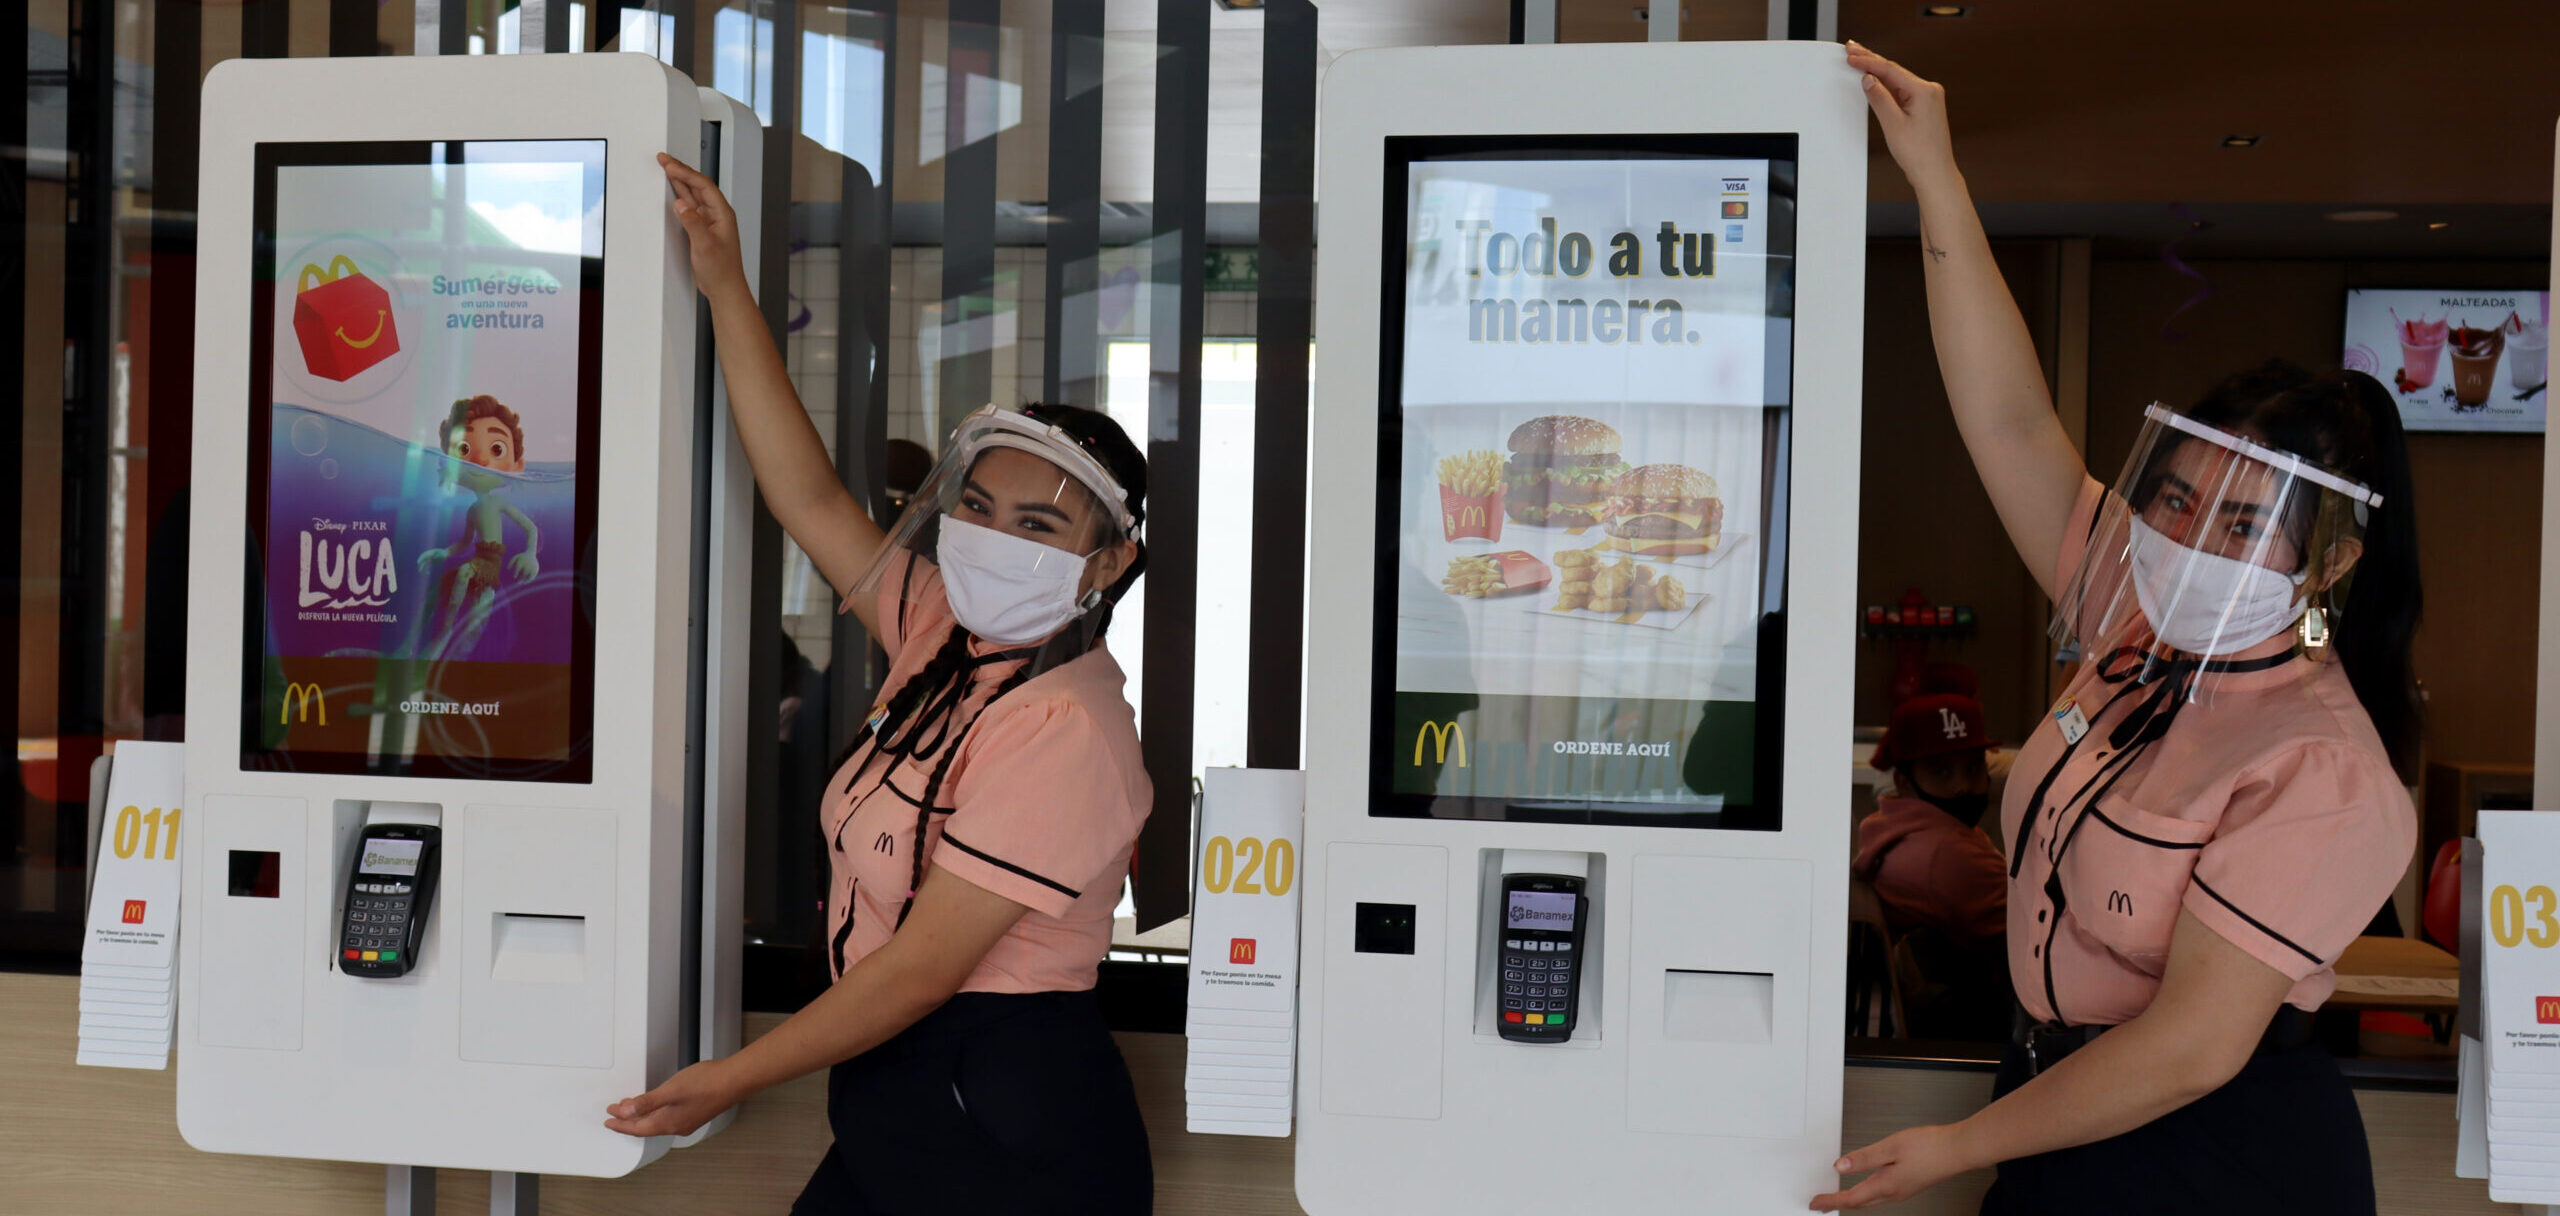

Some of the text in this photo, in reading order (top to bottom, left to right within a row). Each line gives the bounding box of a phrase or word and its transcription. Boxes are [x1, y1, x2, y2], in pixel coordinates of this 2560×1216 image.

[1725, 183, 1746, 191] VISA
[1455, 217, 1717, 279] Todo a tu
[432, 274, 559, 296] Sumérgete
[461, 301, 528, 309] en una nueva
[2441, 297, 2516, 308] MALTEADAS
[446, 310, 544, 329] aventura
[1469, 298, 1702, 345] manera.
[2487, 407, 2523, 415] Chocolate
[312, 518, 387, 534] Disney PIXAR
[299, 530, 398, 608] LUCA
[298, 611, 398, 623] DISFRUTA LA NUEVA PELÍCULA
[400, 701, 500, 716] ORDENE AQUÍ
[1938, 707, 1968, 739] LA
[1553, 741, 1671, 757] ORDENE AQUÍ
[113, 805, 182, 861] 011
[1203, 835, 1295, 897] 020
[1525, 908, 1573, 921] Banamex
